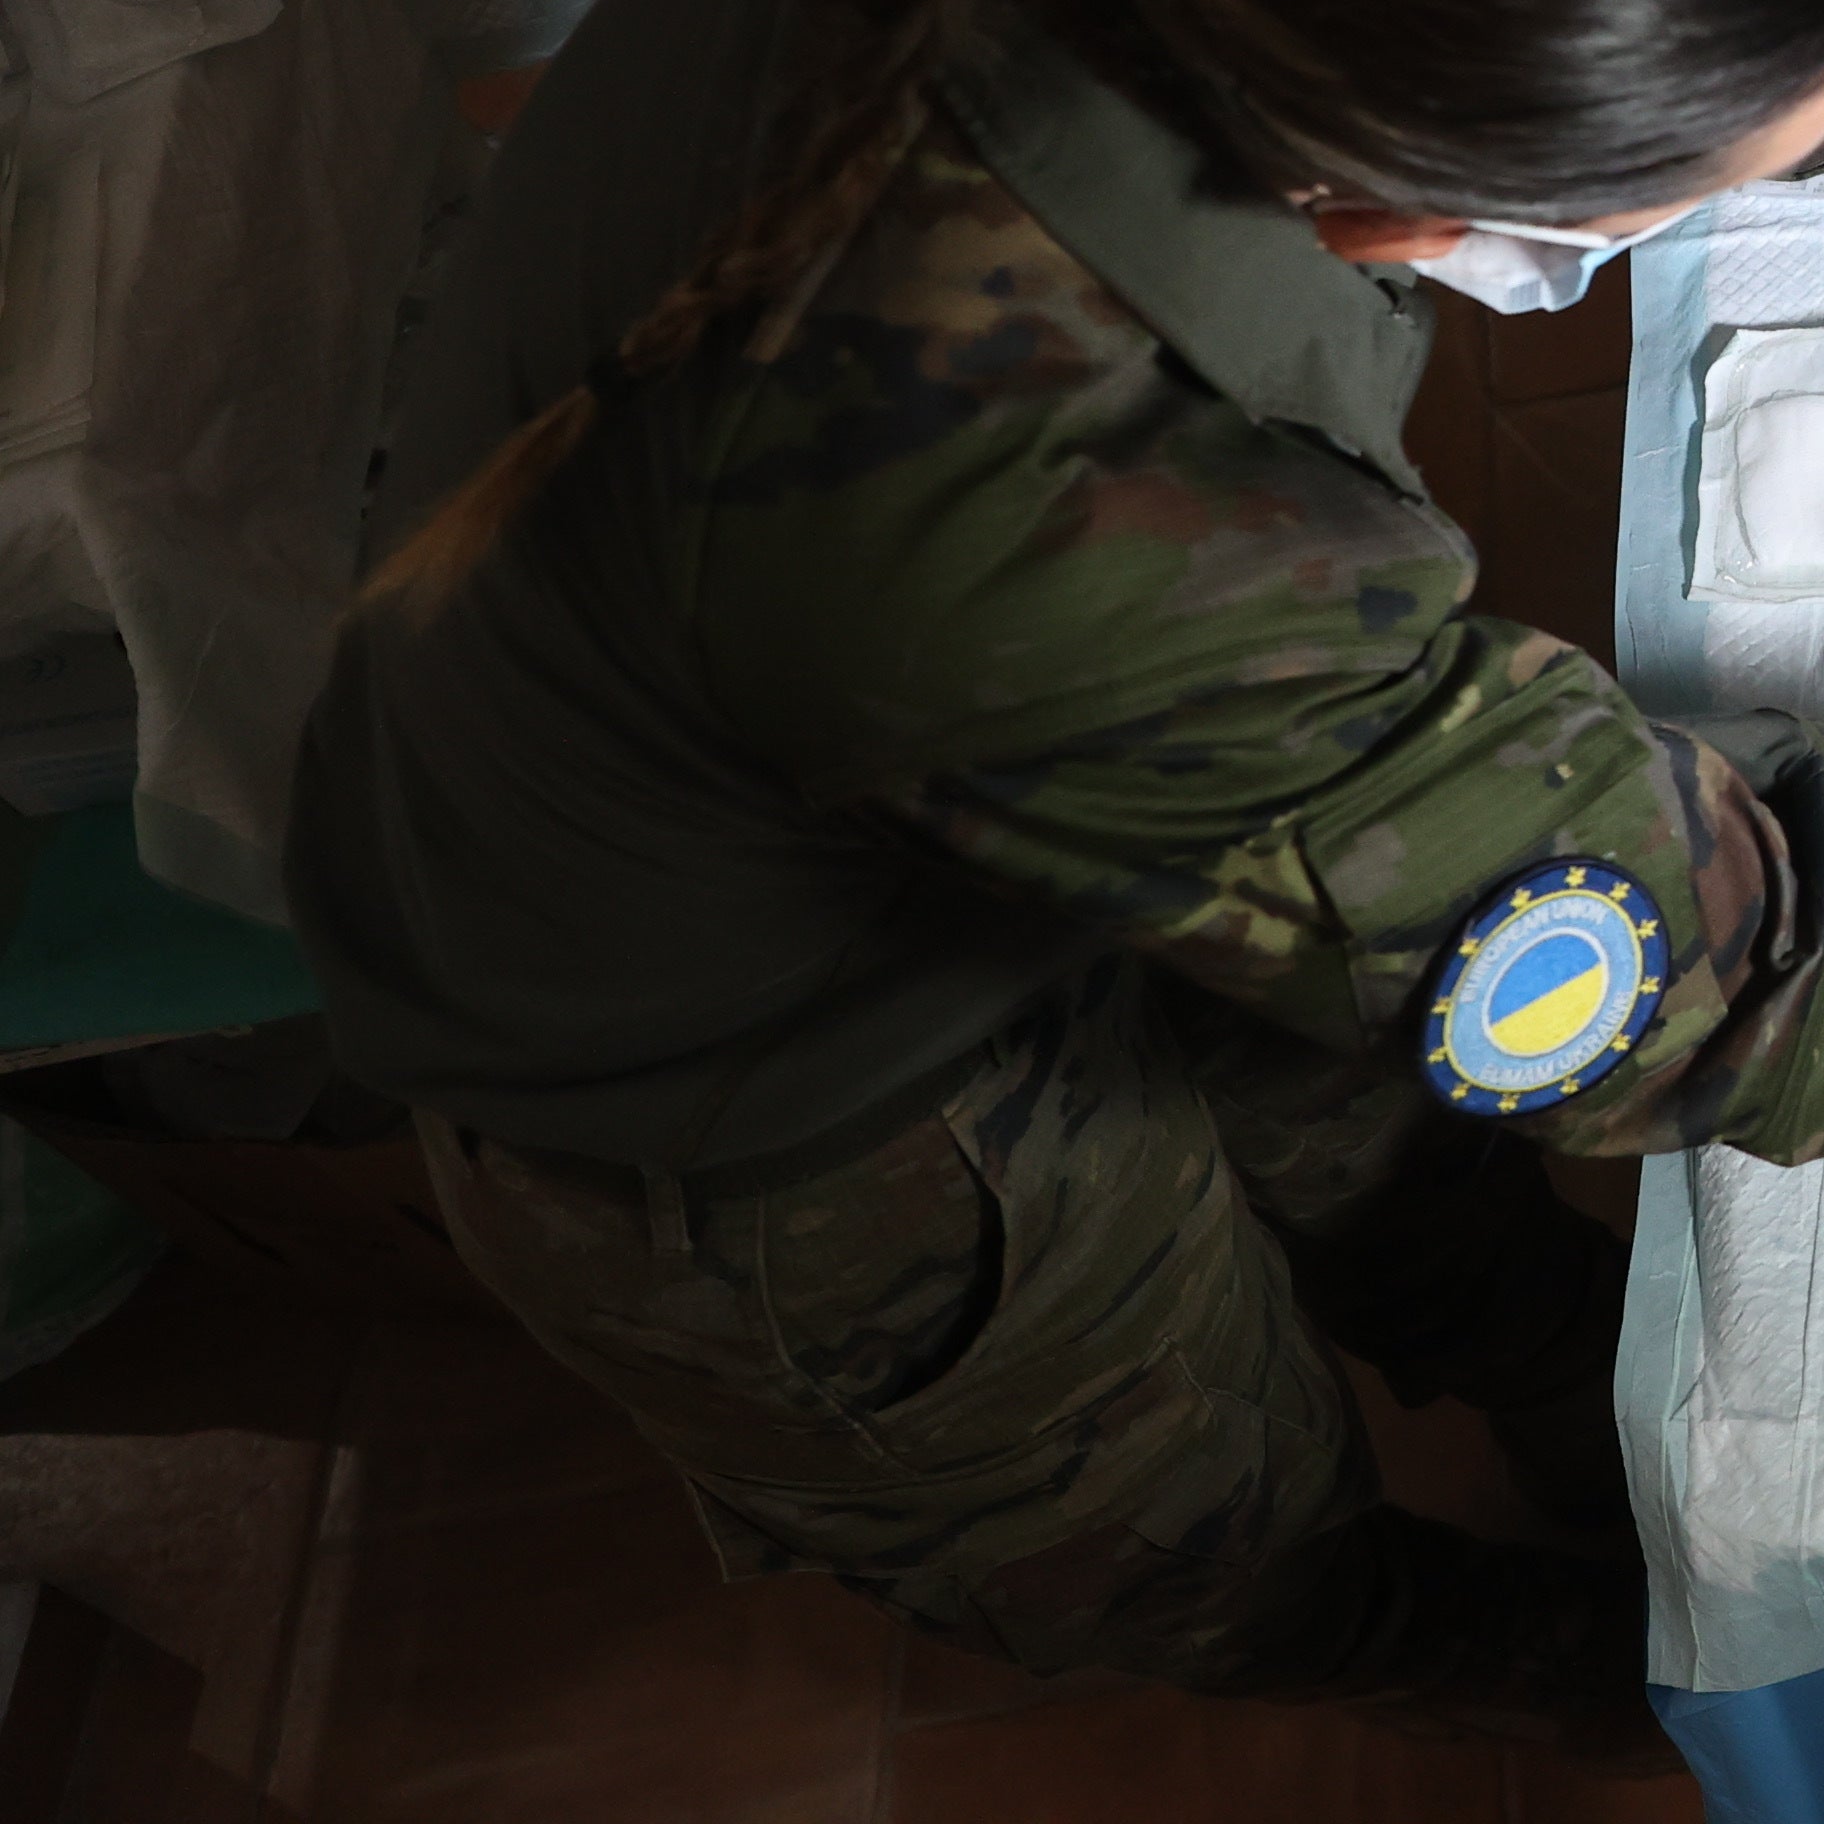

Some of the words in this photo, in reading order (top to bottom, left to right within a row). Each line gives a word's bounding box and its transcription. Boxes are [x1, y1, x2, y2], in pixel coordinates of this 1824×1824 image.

[1459, 907, 1549, 1003] EUROPEAN
[1552, 897, 1607, 924] UNION
[1559, 992, 1632, 1072] UKRAINE
